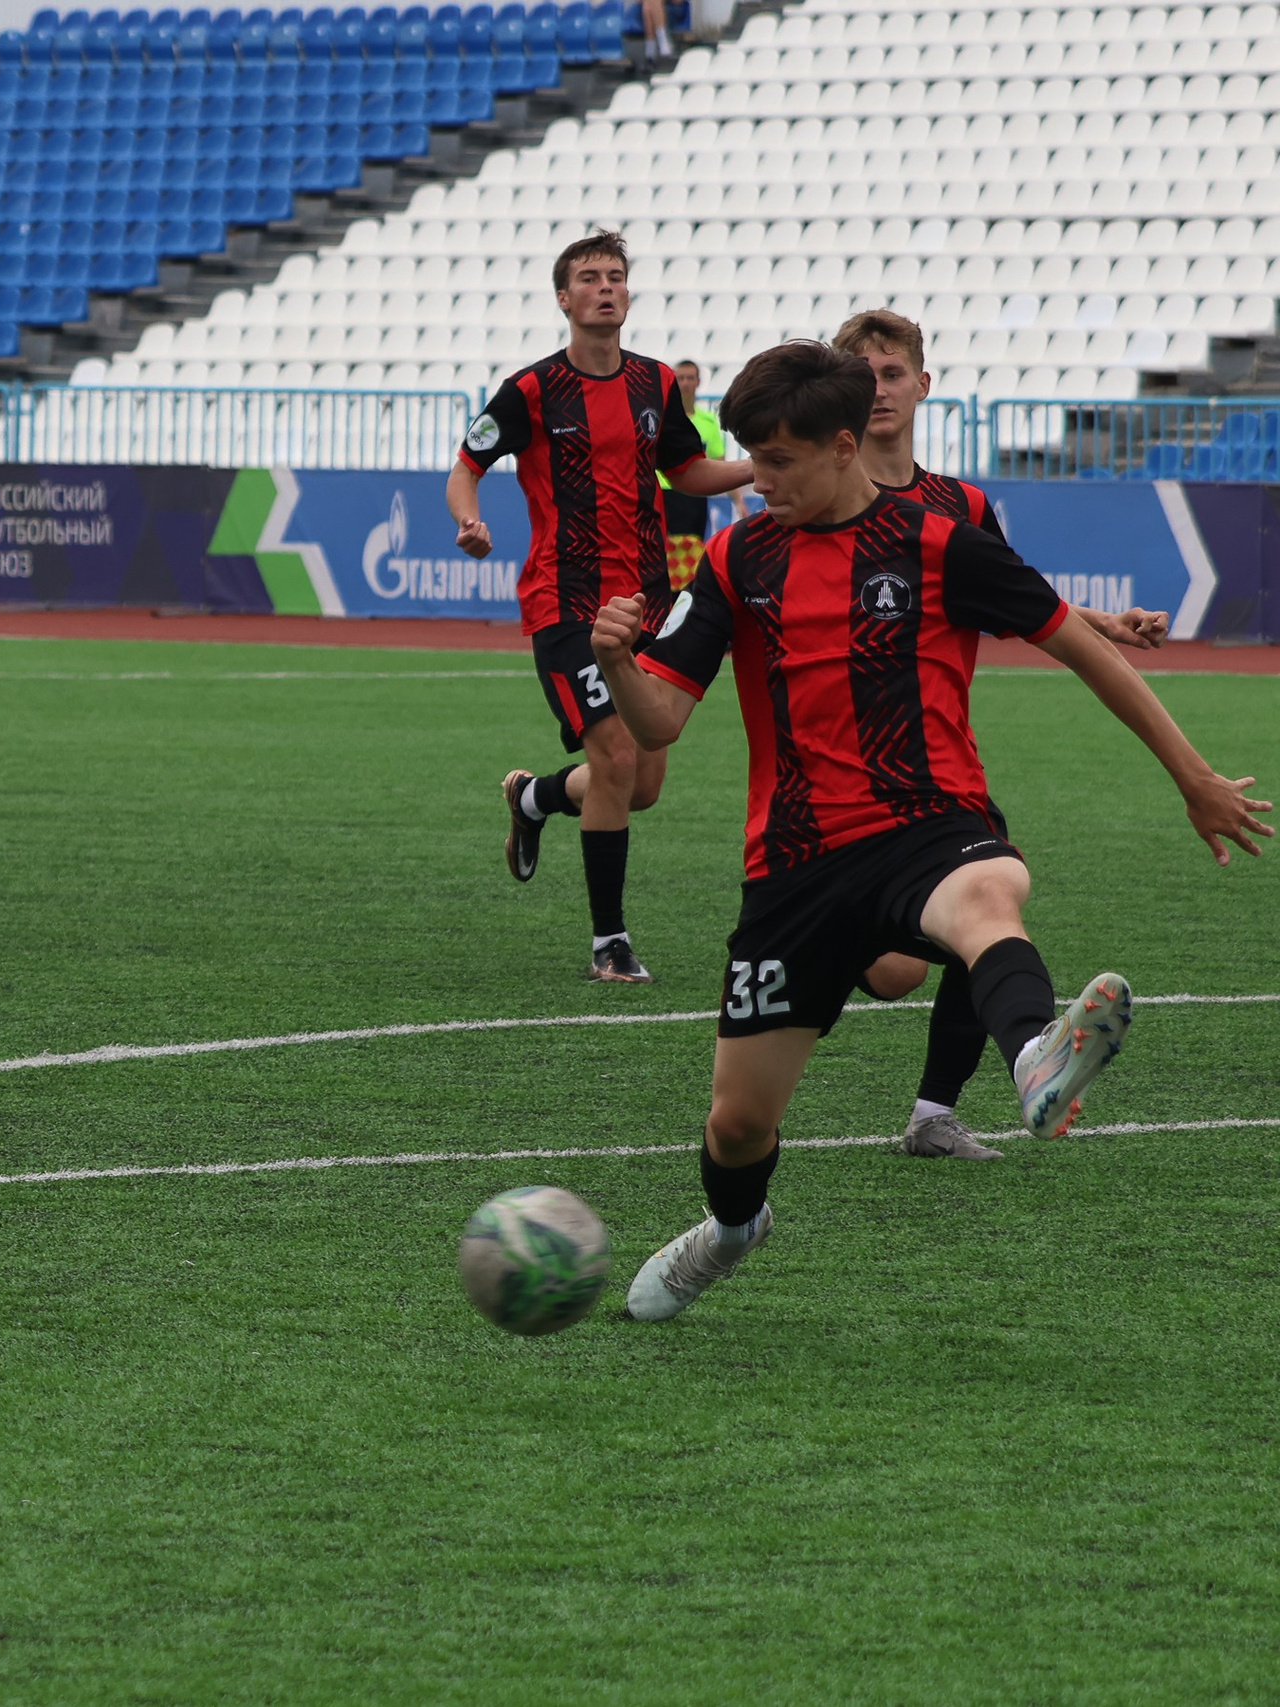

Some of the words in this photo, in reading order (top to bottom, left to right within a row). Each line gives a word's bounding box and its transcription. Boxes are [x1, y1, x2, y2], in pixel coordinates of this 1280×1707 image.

[408, 558, 518, 602] ГАЗПРОМ
[1040, 572, 1134, 616] ПРОМ
[576, 663, 609, 708] 3
[726, 959, 791, 1019] 32
